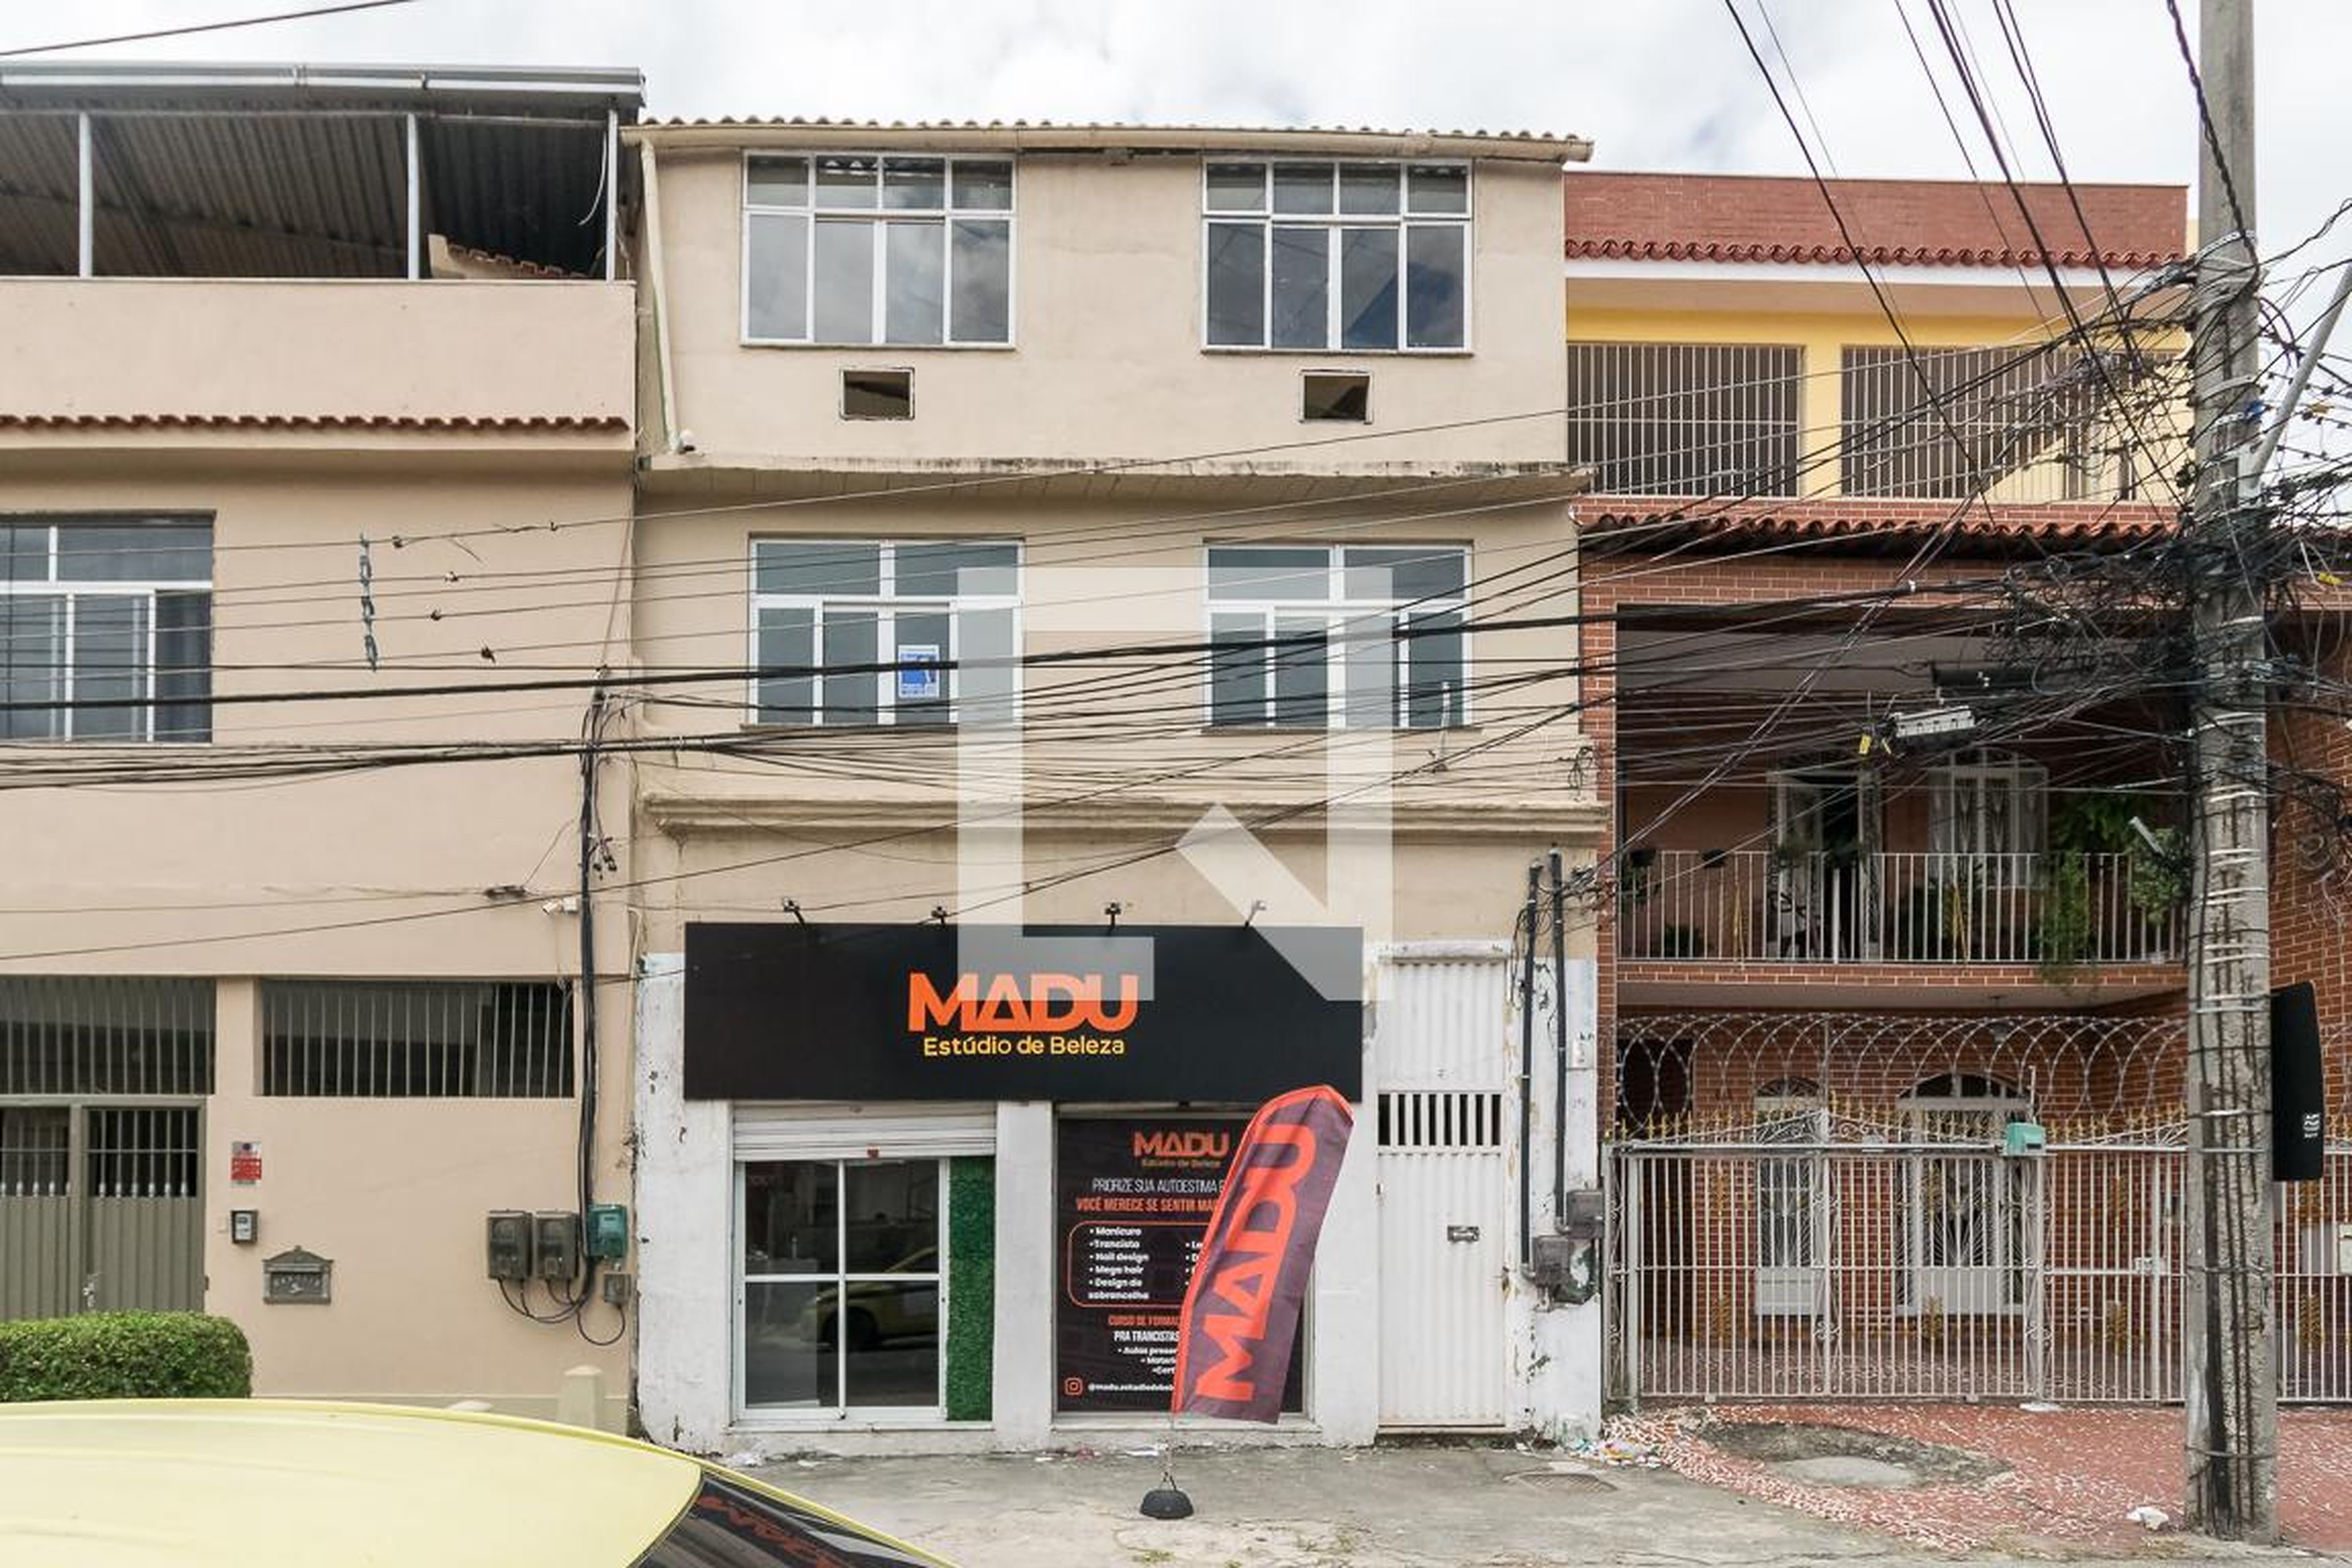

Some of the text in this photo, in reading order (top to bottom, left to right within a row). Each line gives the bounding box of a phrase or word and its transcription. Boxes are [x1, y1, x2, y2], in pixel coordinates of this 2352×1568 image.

[908, 972, 1139, 1033] MADU
[923, 1036, 1125, 1056] Estúdio de Beleza
[1134, 1132, 1230, 1157] MADU
[1134, 1178, 1155, 1194] SUA
[1157, 1178, 1217, 1194] AUTOESTIMA
[1145, 1198, 1158, 1212] SE
[1196, 1123, 1316, 1402] MADU
[1114, 1330, 1131, 1342] PRA
